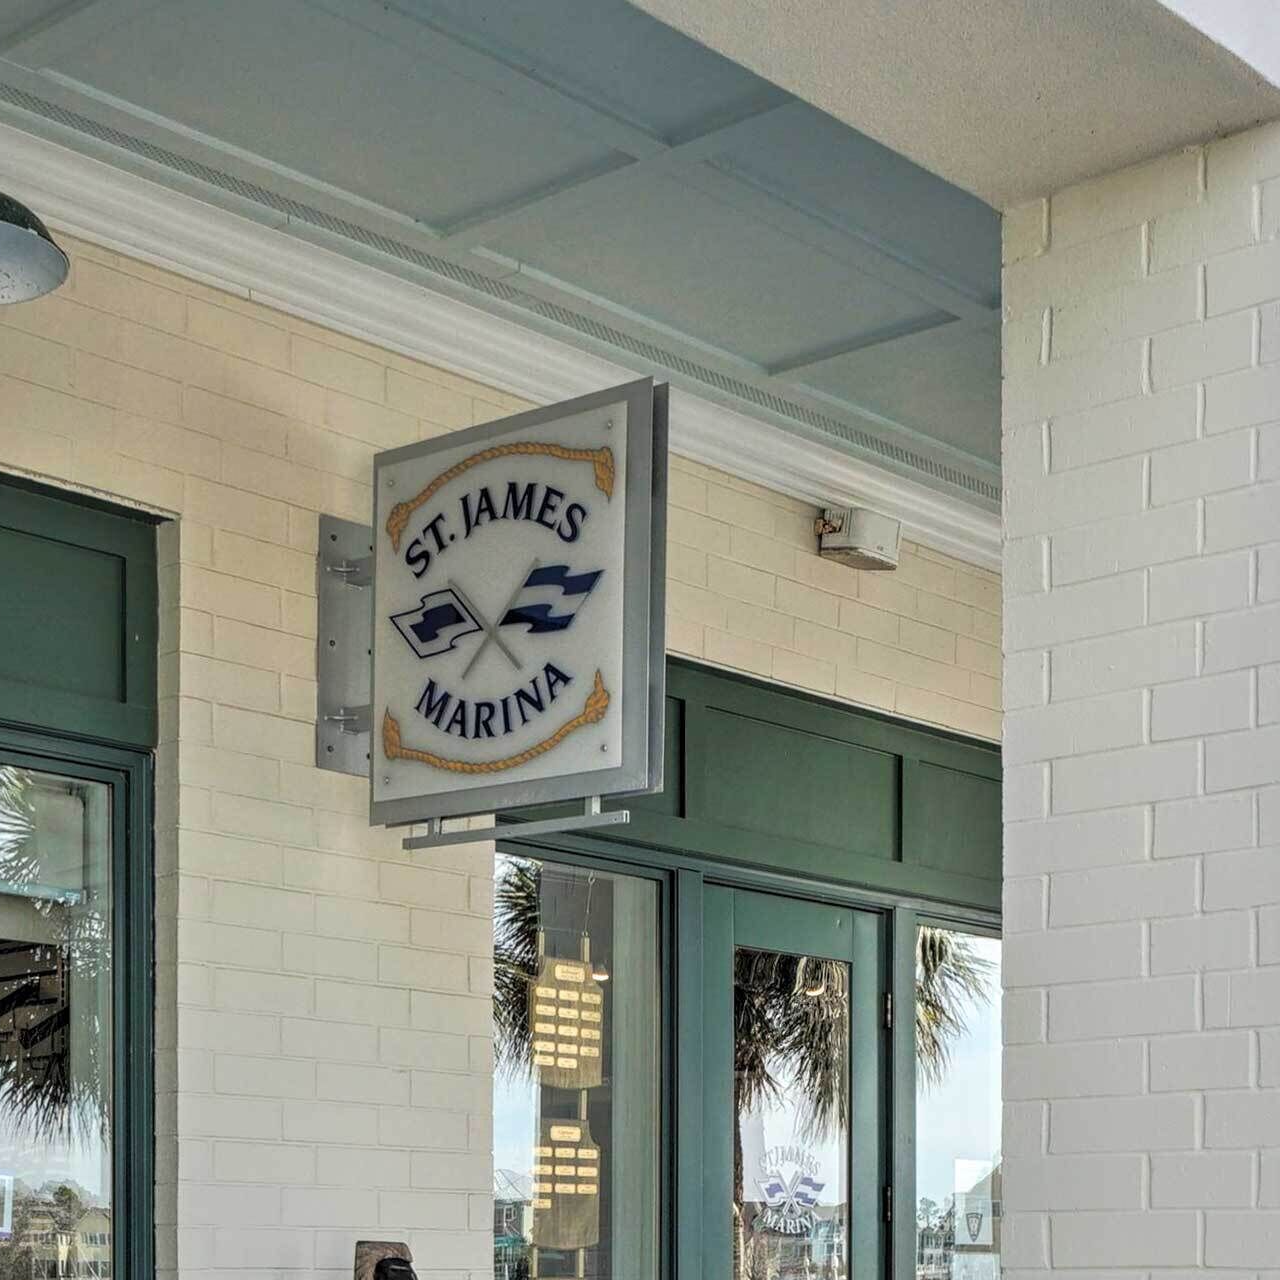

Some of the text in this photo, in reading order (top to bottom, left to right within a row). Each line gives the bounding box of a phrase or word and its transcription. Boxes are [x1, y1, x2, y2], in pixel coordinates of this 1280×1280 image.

[404, 481, 587, 579] ST. JAMES
[413, 662, 572, 739] MARINA
[763, 1208, 819, 1234] MARIN
